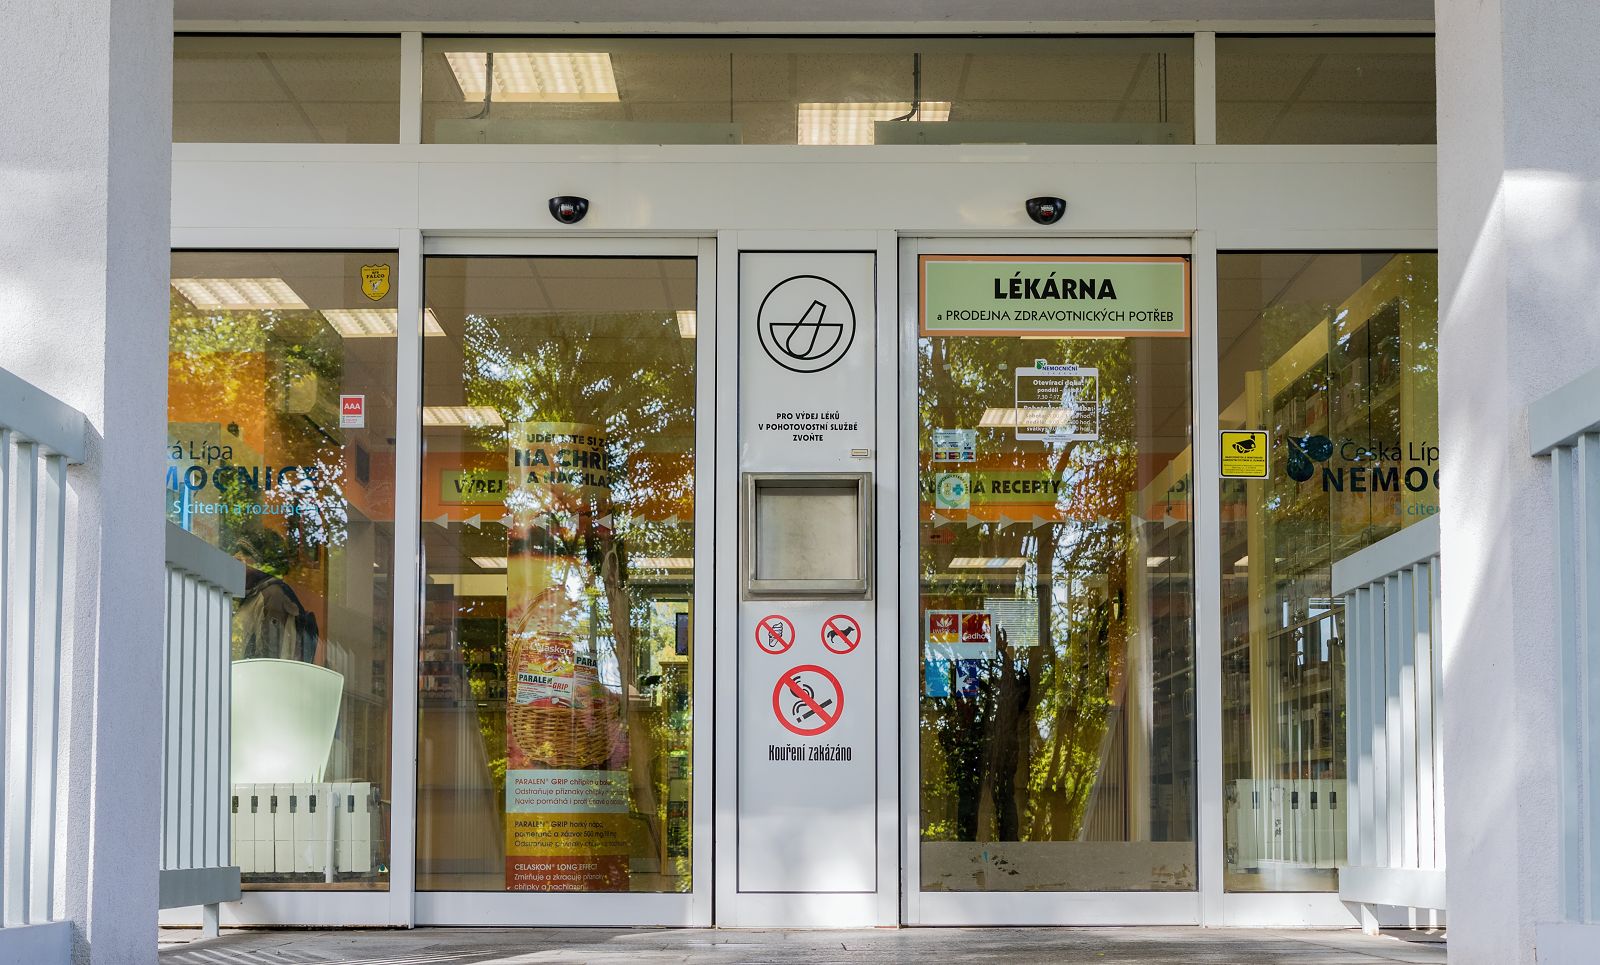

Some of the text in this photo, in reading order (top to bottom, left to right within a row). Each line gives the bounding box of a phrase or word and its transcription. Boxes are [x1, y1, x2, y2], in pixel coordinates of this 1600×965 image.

[994, 271, 1117, 300] LÉKÁRNA
[946, 309, 1011, 321] PRODEJNA
[1014, 307, 1125, 322] ZDRAVOTNICKÝCH
[1129, 308, 1174, 322] POTŘEB
[777, 410, 840, 420] PRO VÝDEJ LÉKŮ
[766, 422, 828, 430] POHOTOVOSTNÍ
[830, 421, 858, 430] SLUŽBĚ
[526, 431, 585, 446] UDĚLTE
[793, 432, 823, 441] ZVOŇTE
[189, 440, 233, 465] Lípa
[1340, 438, 1402, 462] Česká
[515, 448, 549, 467] NA
[454, 474, 503, 494] VÝDEJ
[526, 471, 540, 484] A
[991, 480, 1061, 494] RECEPTY
[173, 500, 181, 514] S
[187, 500, 229, 514] citem
[552, 682, 568, 691] GRIP
[768, 744, 852, 761] Kouření zakázáno
[514, 788, 553, 796] Odstraňuje
[555, 788, 583, 796] příznaky
[514, 883, 539, 891] chřipky
